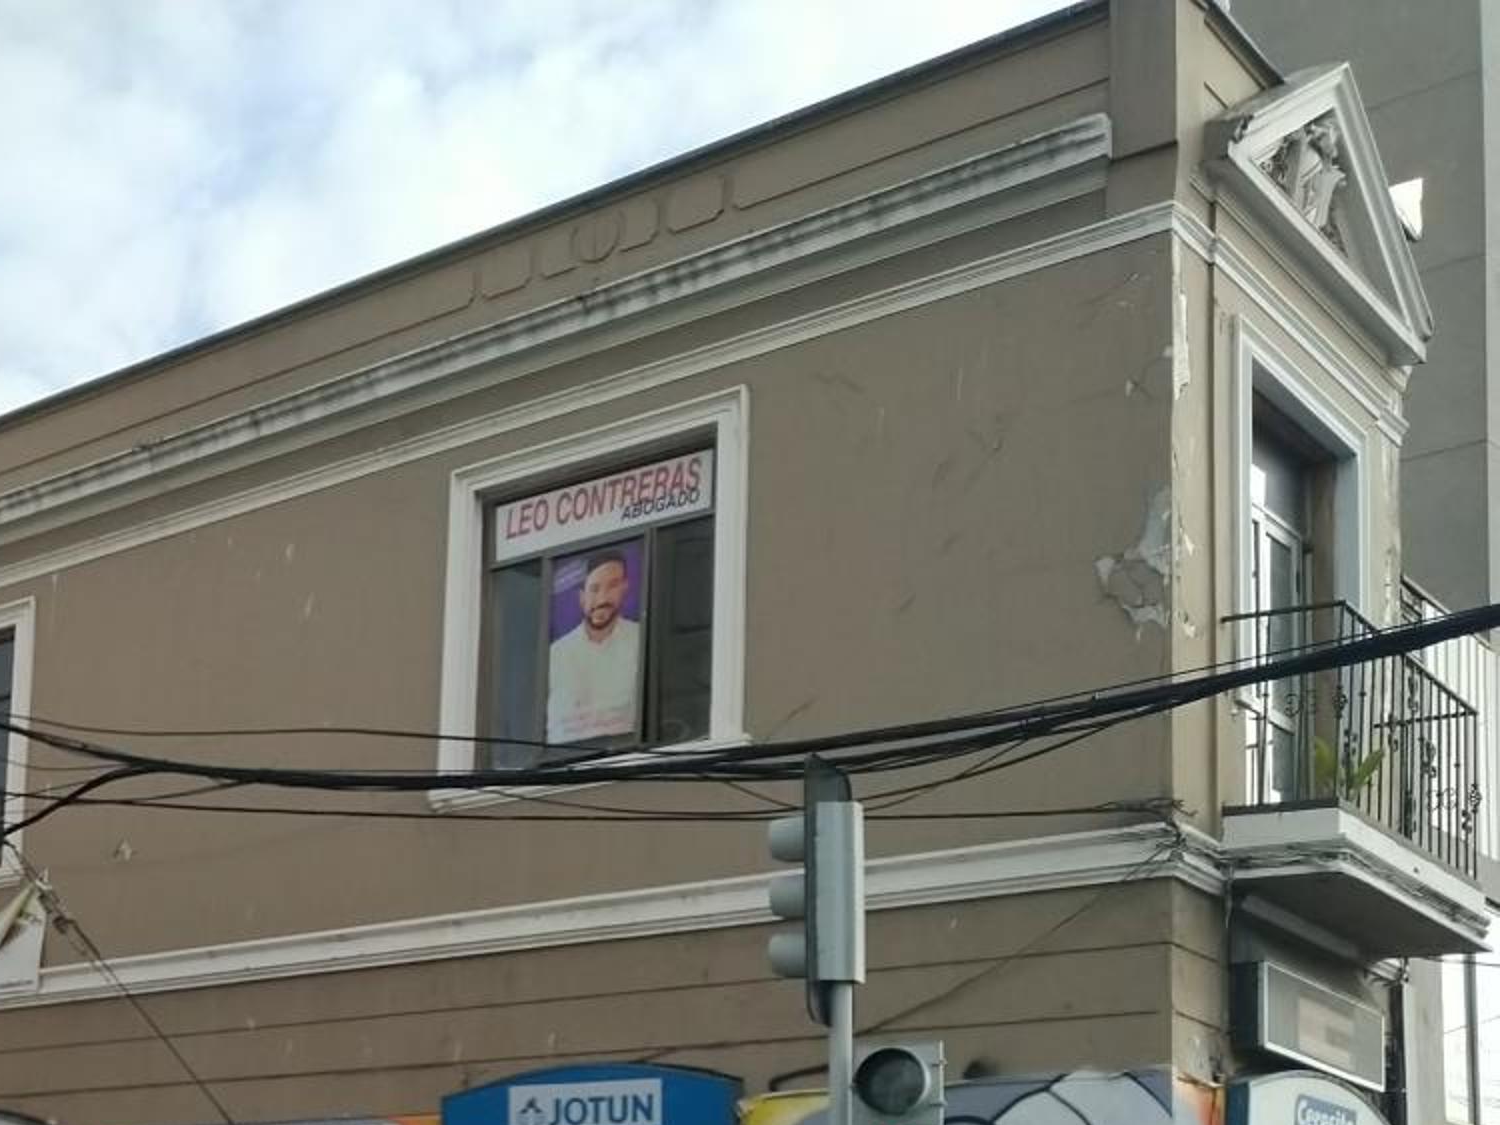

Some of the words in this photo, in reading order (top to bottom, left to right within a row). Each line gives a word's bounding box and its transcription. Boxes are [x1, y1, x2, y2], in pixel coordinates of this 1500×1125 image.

[506, 498, 549, 540] LEO
[556, 457, 703, 525] CONTRERAS
[621, 487, 700, 522] ABOGADO
